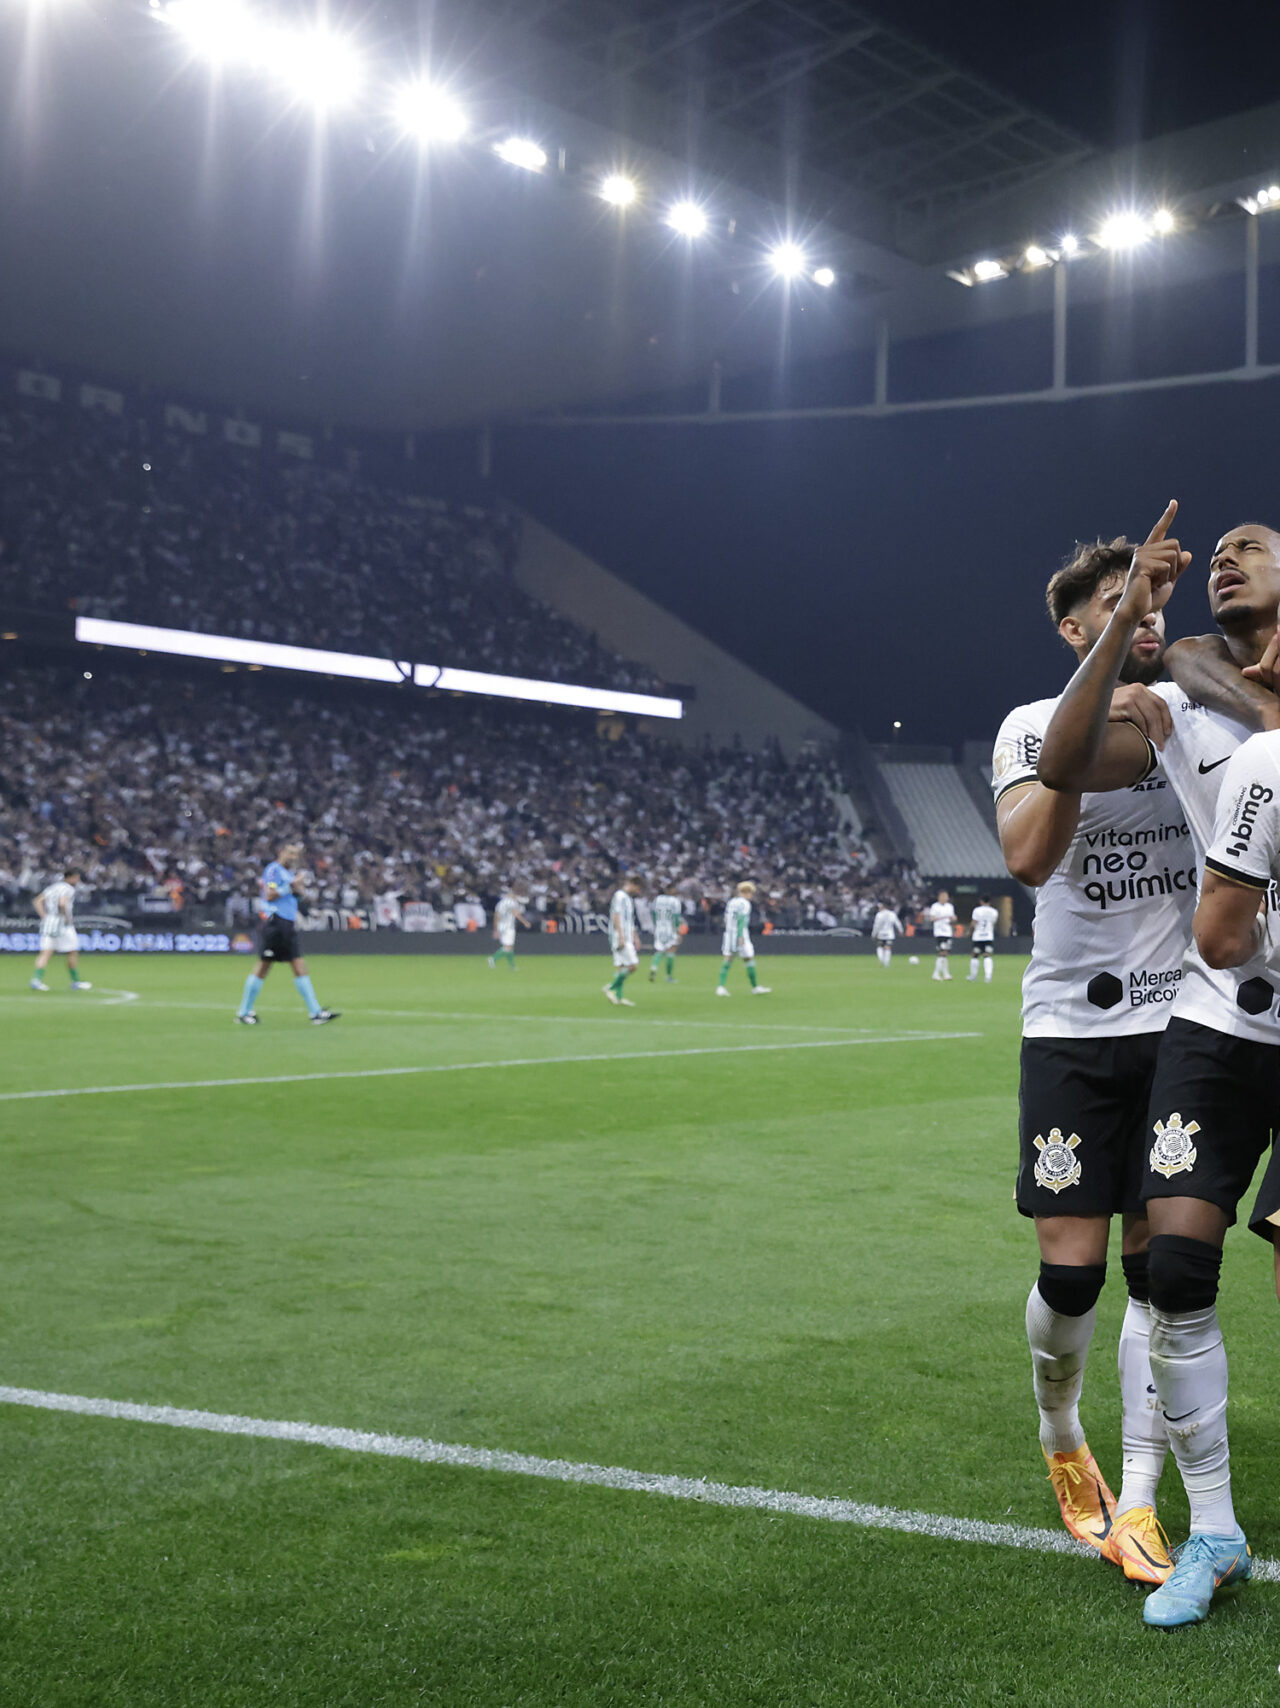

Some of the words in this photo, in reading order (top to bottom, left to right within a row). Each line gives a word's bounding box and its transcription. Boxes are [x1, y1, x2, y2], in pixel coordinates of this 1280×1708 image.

[1085, 823, 1191, 848] vitamina
[1083, 851, 1147, 875] neo
[1129, 968, 1182, 988] Merca
[1130, 983, 1180, 1007] Bitcoi
